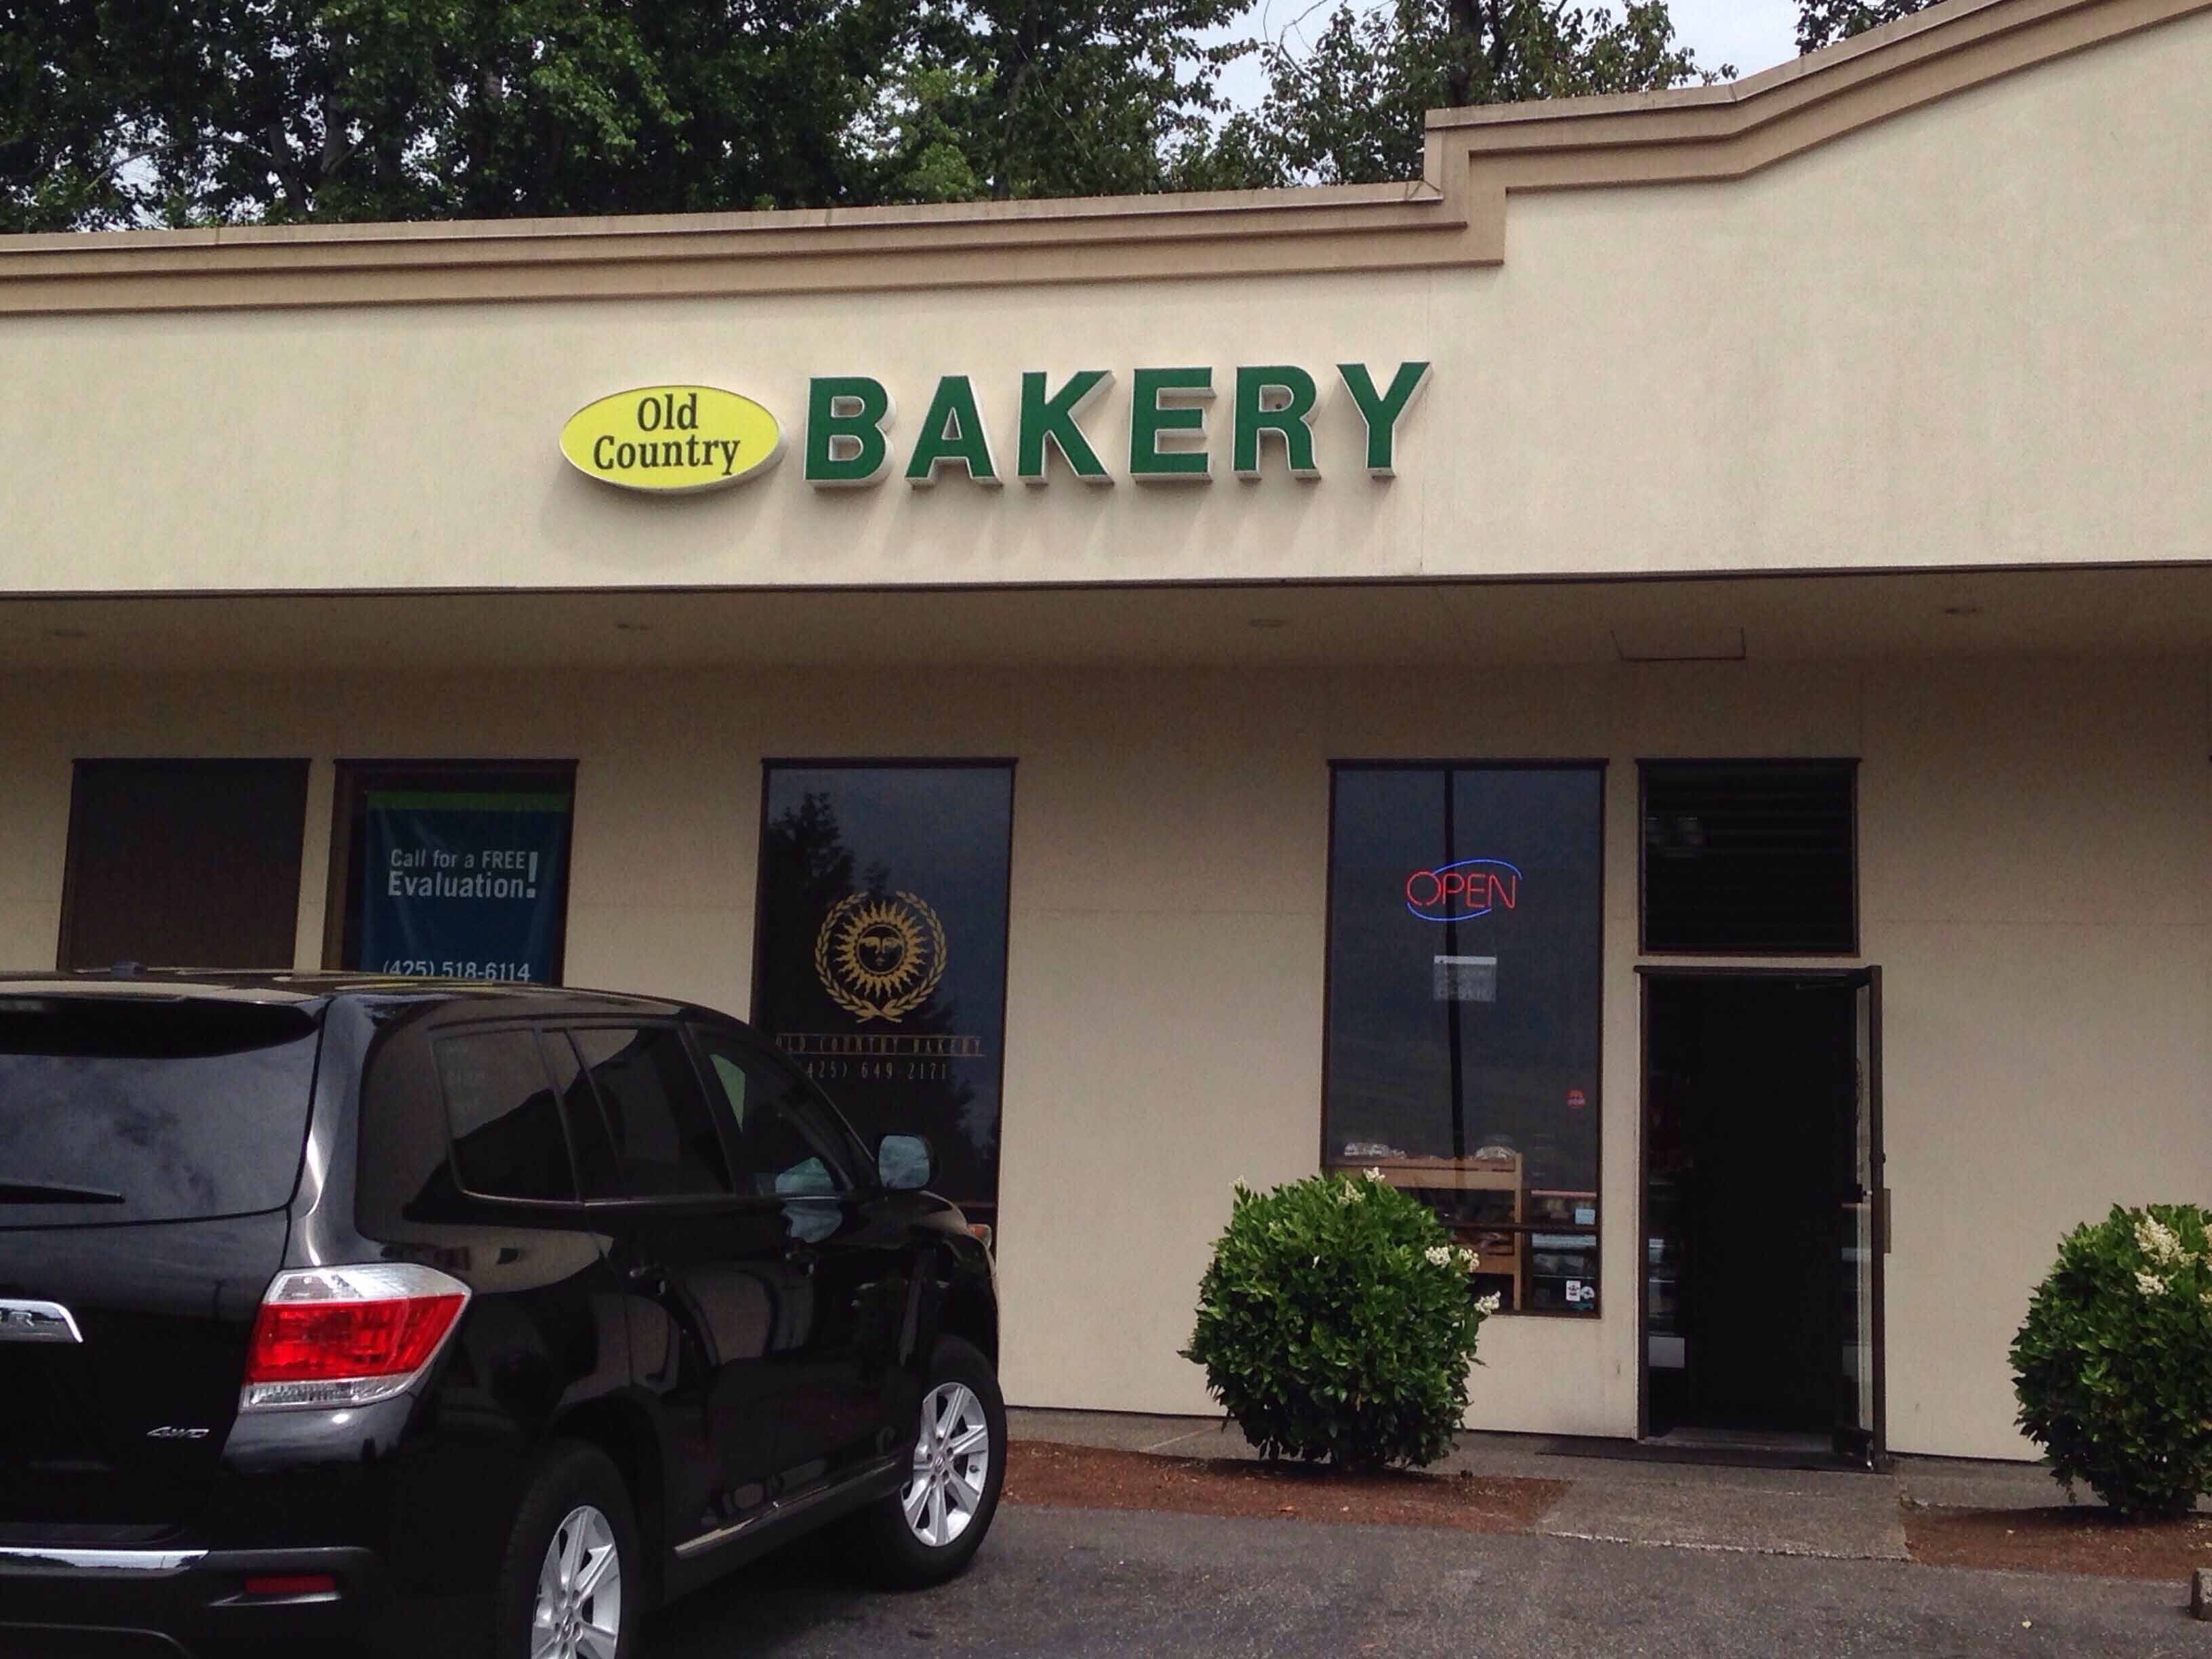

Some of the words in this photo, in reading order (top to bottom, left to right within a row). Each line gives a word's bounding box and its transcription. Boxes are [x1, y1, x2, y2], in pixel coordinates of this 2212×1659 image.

[637, 392, 699, 432] Old
[804, 361, 1431, 482] BAKERY
[593, 434, 741, 476] Country
[390, 848, 426, 868] Call
[432, 849, 458, 868] for
[464, 853, 475, 869] a
[482, 851, 527, 869] FREE
[1406, 870, 1517, 909] OPEN
[442, 961, 531, 981] 518-6114
